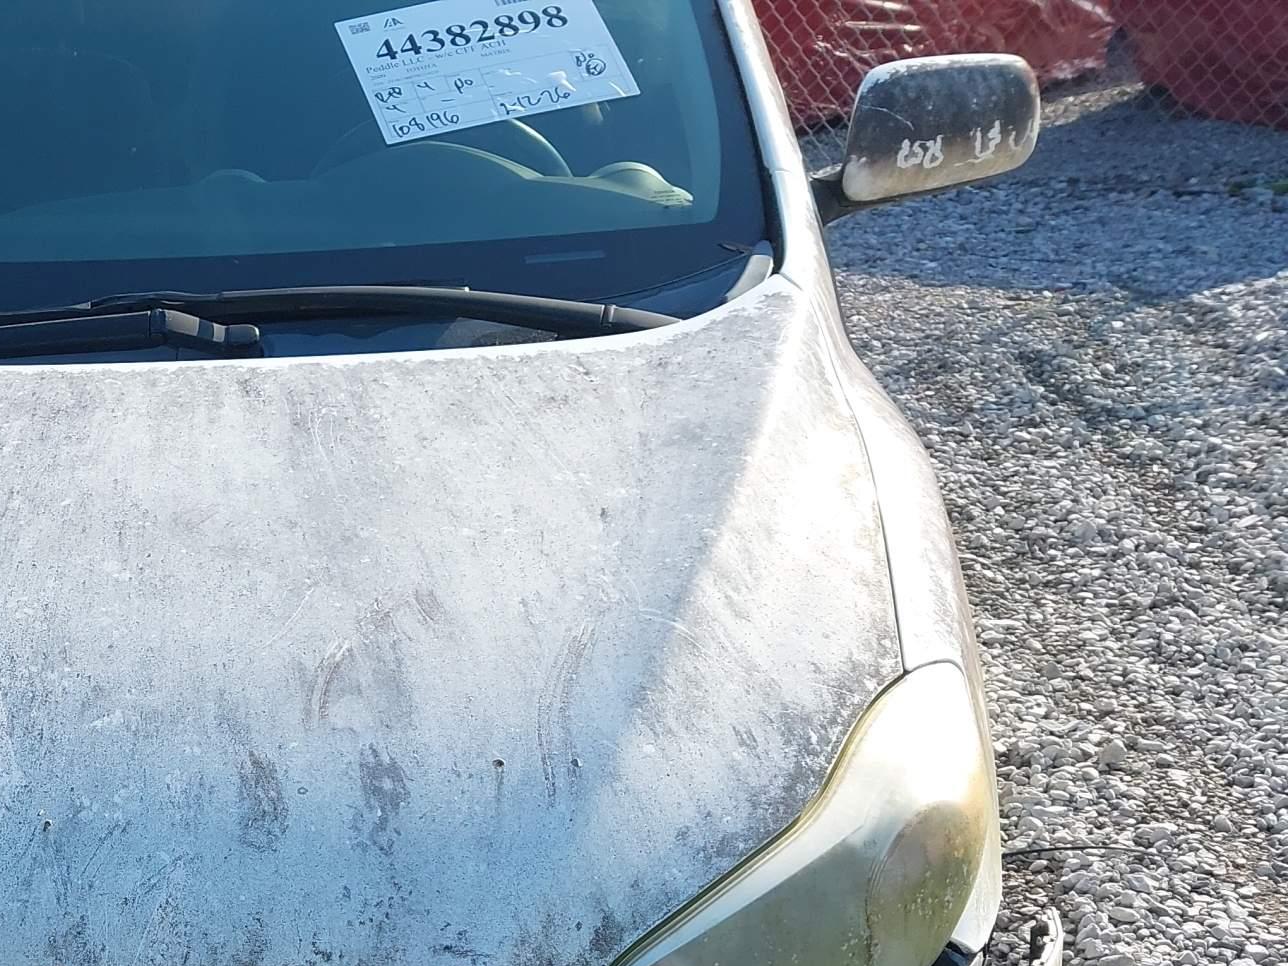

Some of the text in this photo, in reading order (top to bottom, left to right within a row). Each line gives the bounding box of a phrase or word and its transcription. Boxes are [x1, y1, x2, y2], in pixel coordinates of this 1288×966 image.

[376, 6, 569, 60] 44382898
[365, 62, 400, 74] Peddle
[402, 55, 425, 67] LLC
